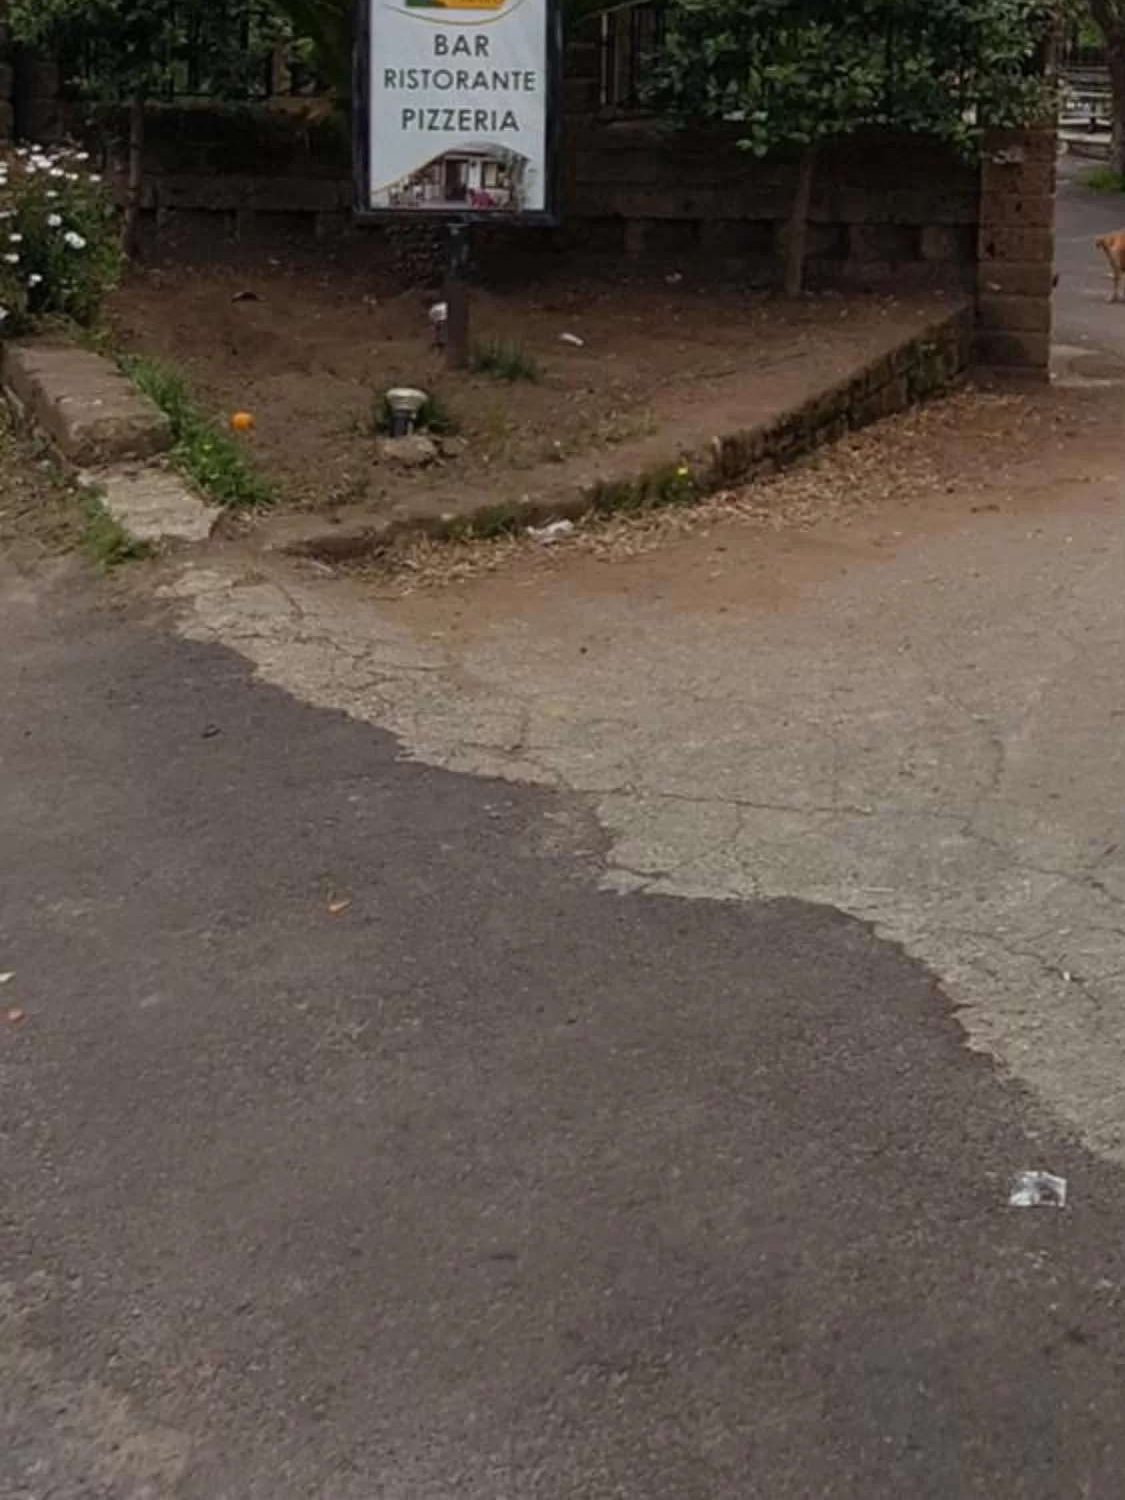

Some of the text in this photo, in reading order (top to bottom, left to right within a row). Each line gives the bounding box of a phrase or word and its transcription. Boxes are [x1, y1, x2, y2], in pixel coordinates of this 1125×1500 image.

[433, 33, 490, 58] BAR
[383, 68, 537, 92] RISTORANTE
[401, 108, 521, 133] PIZZERIA
